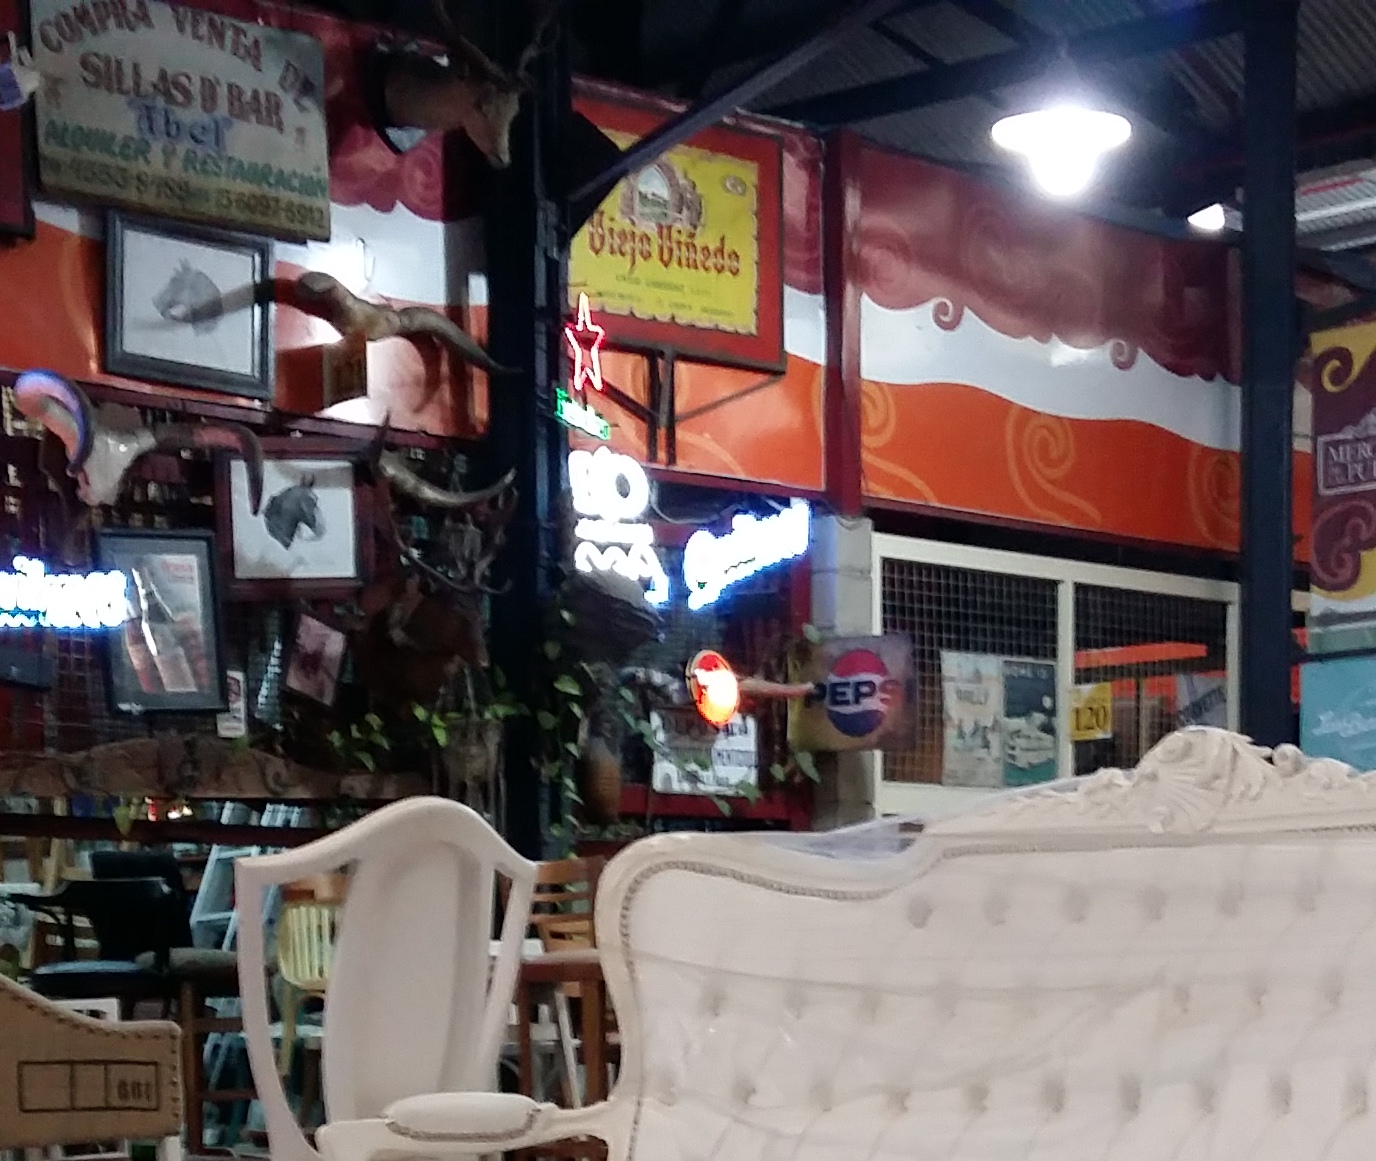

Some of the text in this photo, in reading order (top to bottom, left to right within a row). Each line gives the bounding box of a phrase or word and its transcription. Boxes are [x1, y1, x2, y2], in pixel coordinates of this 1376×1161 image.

[171, 5, 263, 72] VENTA
[79, 52, 194, 108] SILLAS
[226, 81, 286, 134] BAR
[588, 210, 741, 278] Viejo Viñedo
